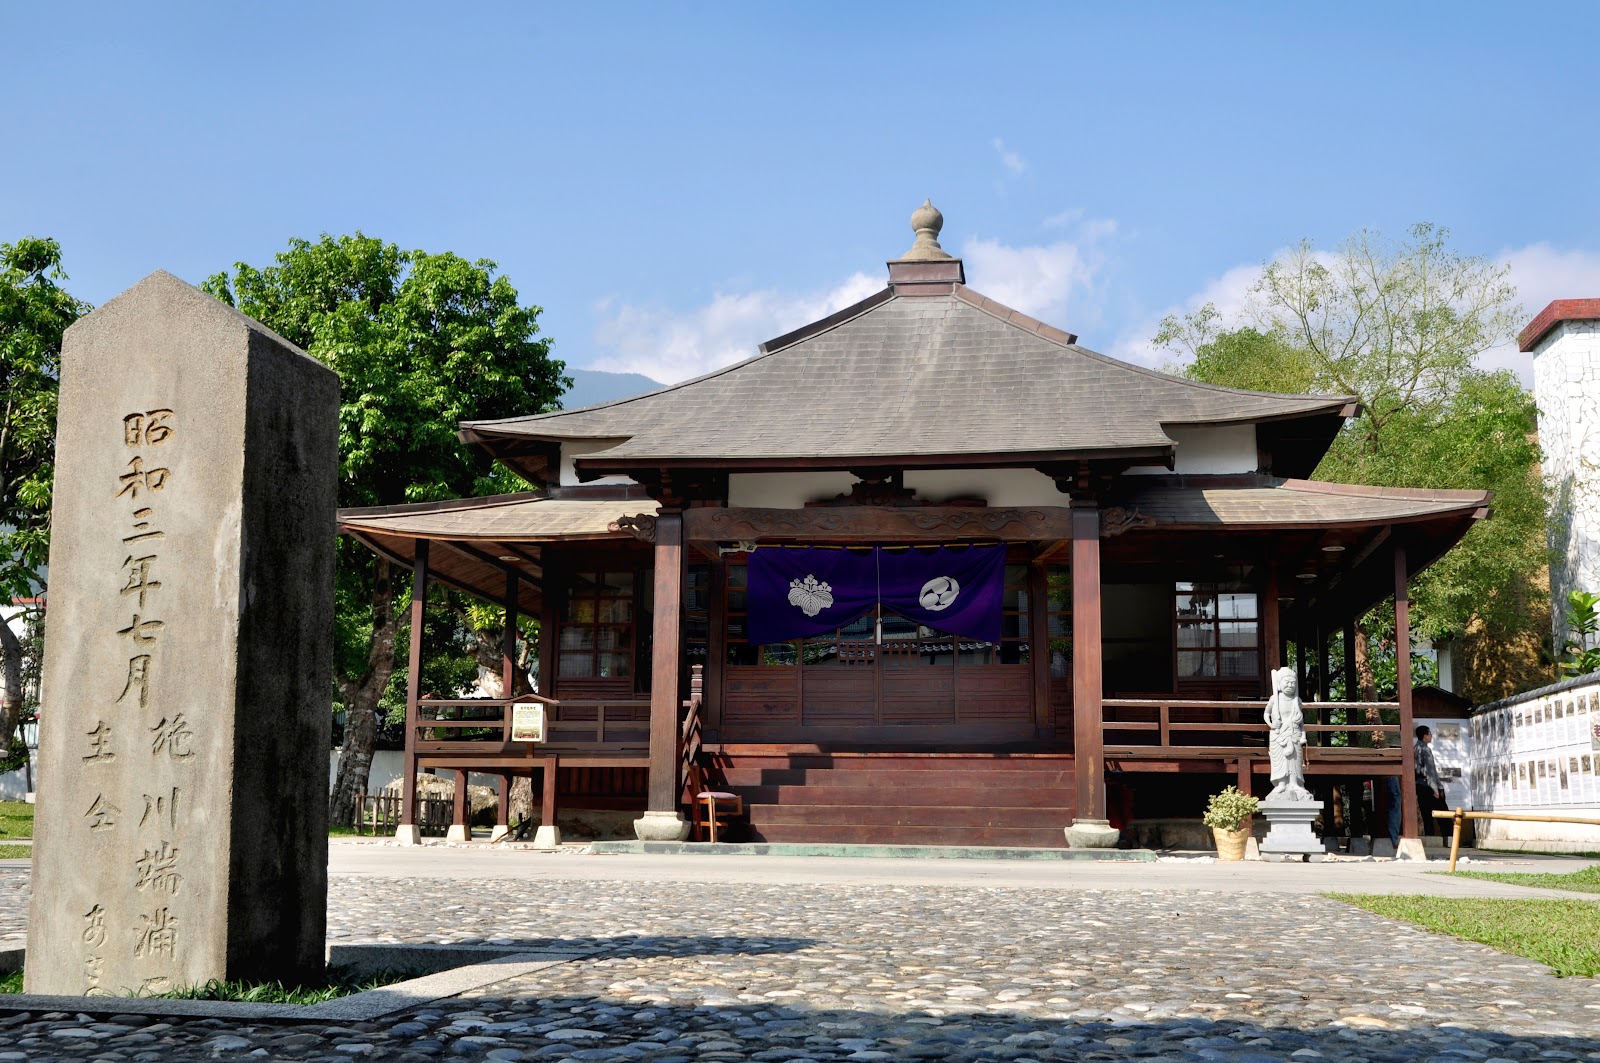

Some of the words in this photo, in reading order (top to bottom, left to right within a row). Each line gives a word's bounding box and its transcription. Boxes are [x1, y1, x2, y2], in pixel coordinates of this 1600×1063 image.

[115, 408, 174, 709] 昭和三年七月
